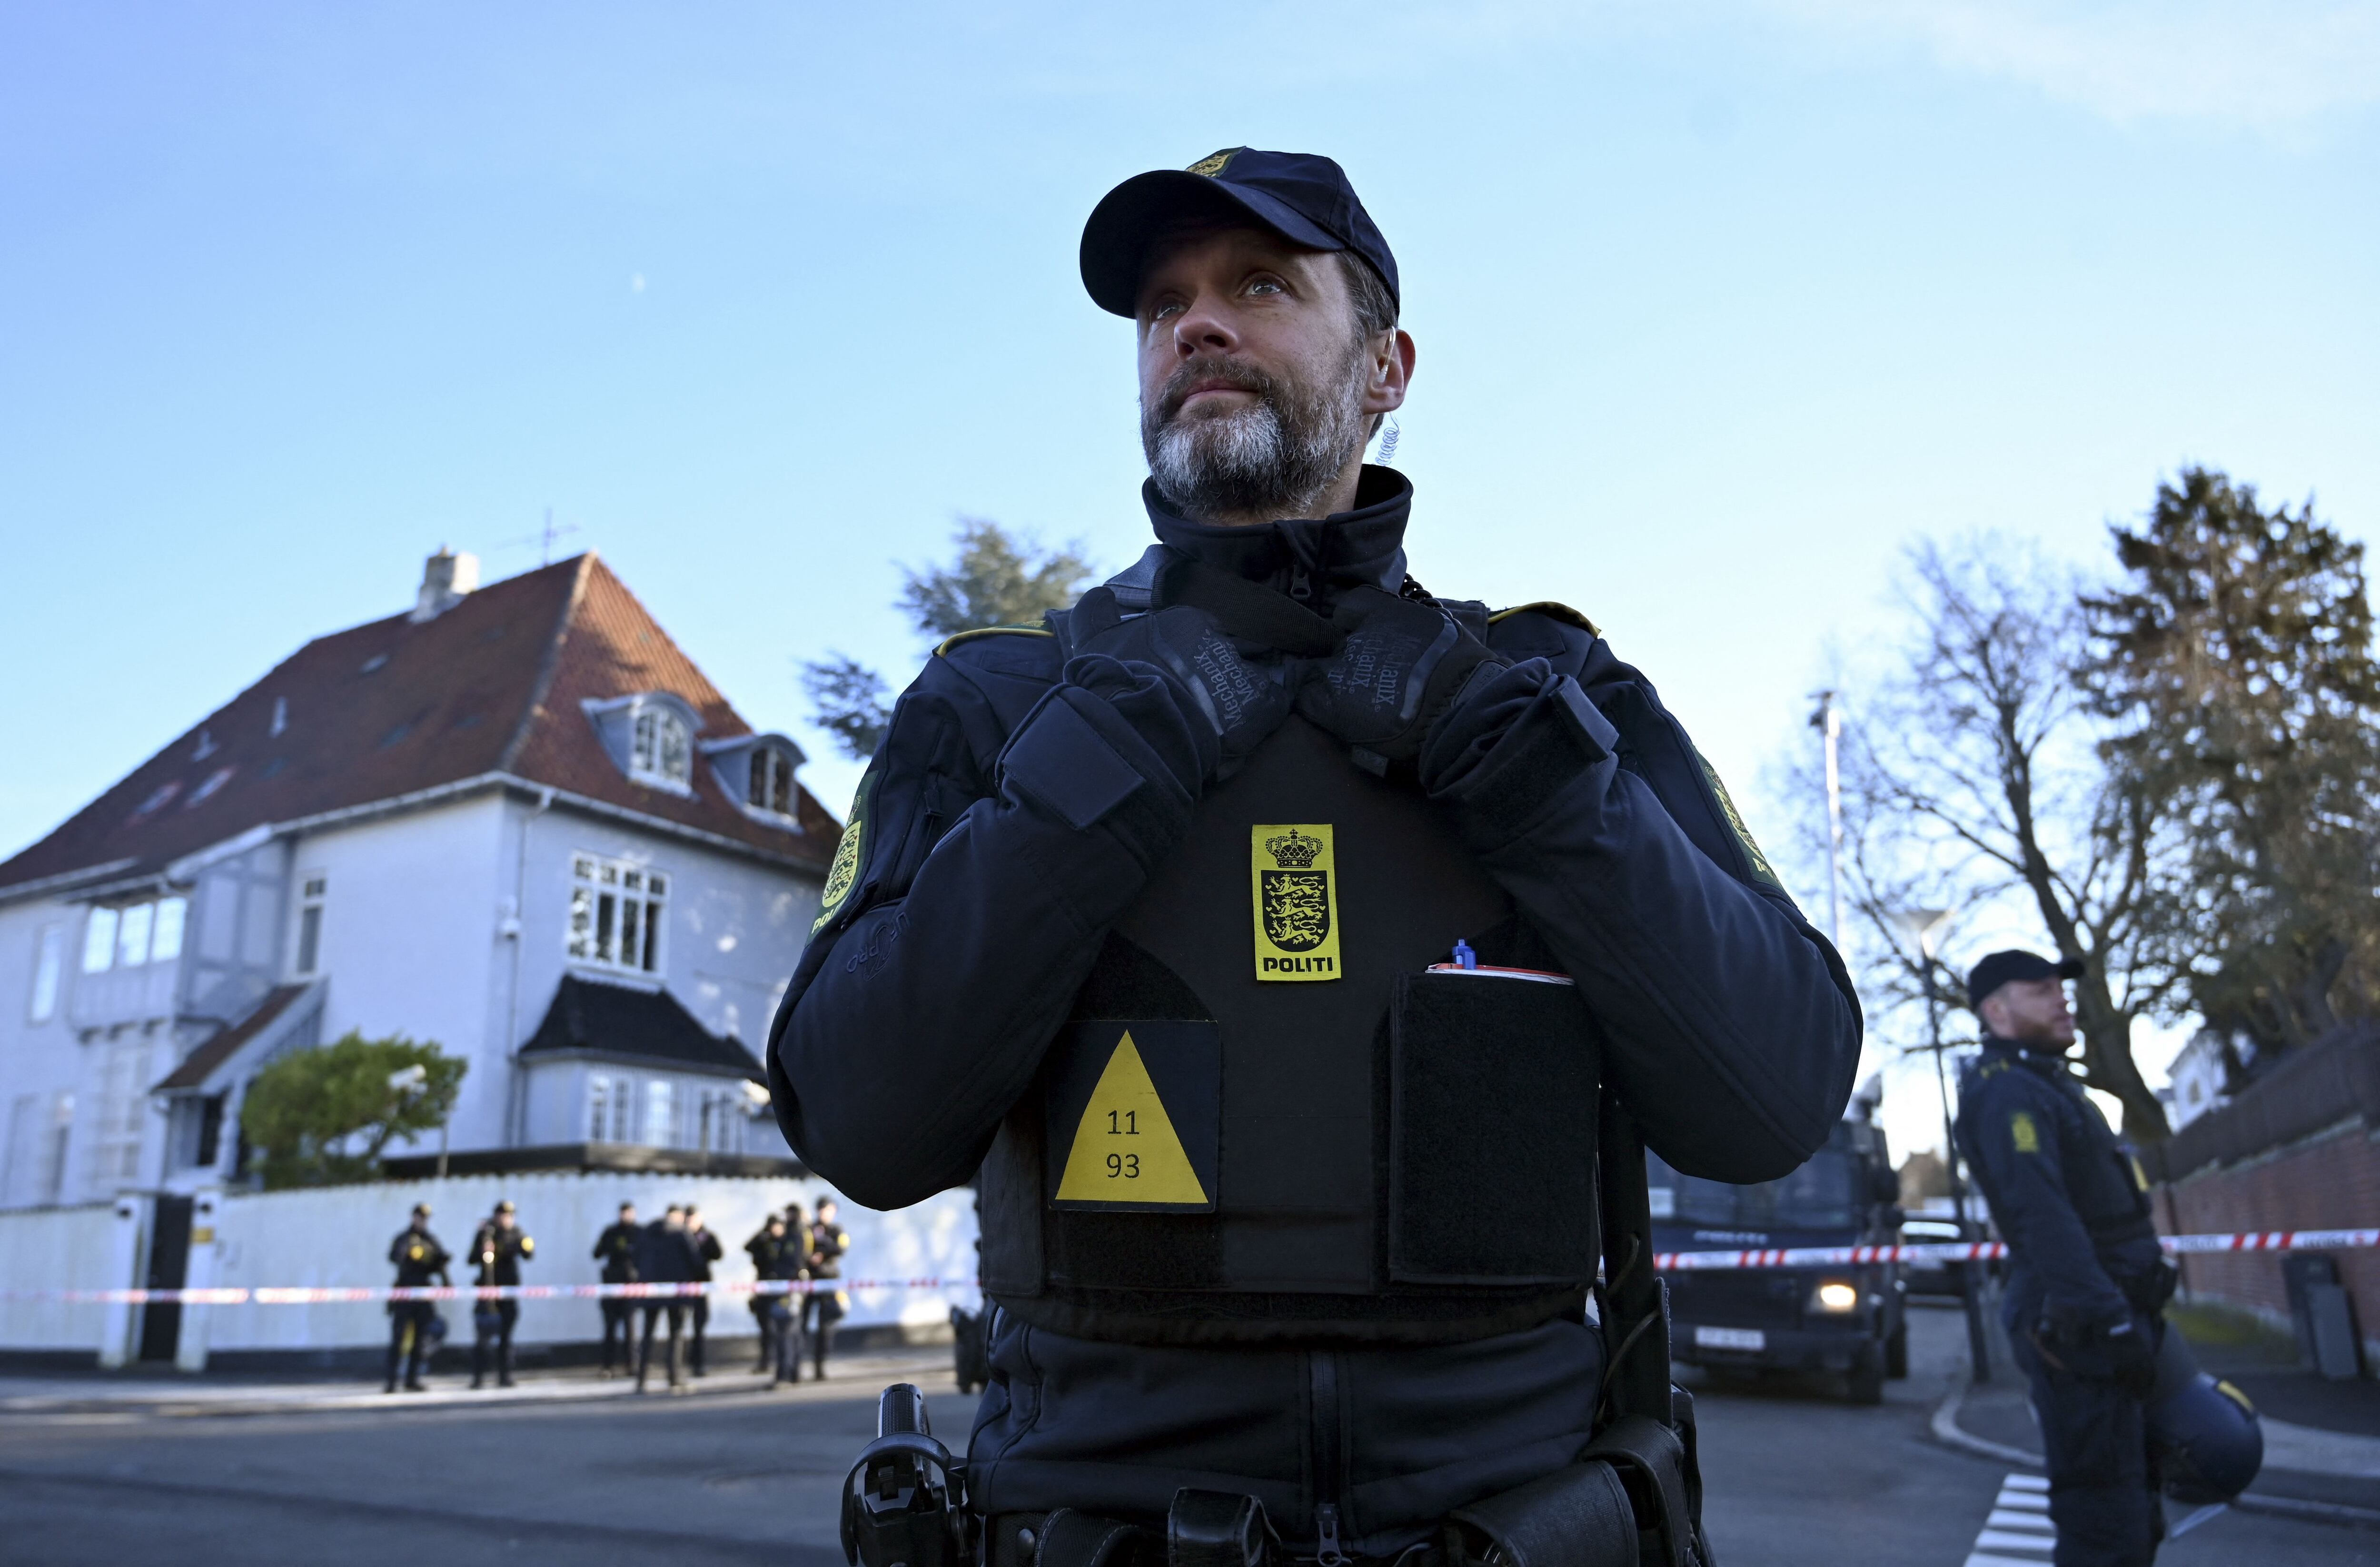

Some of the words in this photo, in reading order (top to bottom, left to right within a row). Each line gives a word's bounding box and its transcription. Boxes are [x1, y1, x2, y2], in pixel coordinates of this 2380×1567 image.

[1194, 650, 1247, 732] Mechanix
[1263, 957, 1333, 972] POLITI
[1107, 1110, 1140, 1135] 11
[1106, 1153, 1140, 1179] 93
